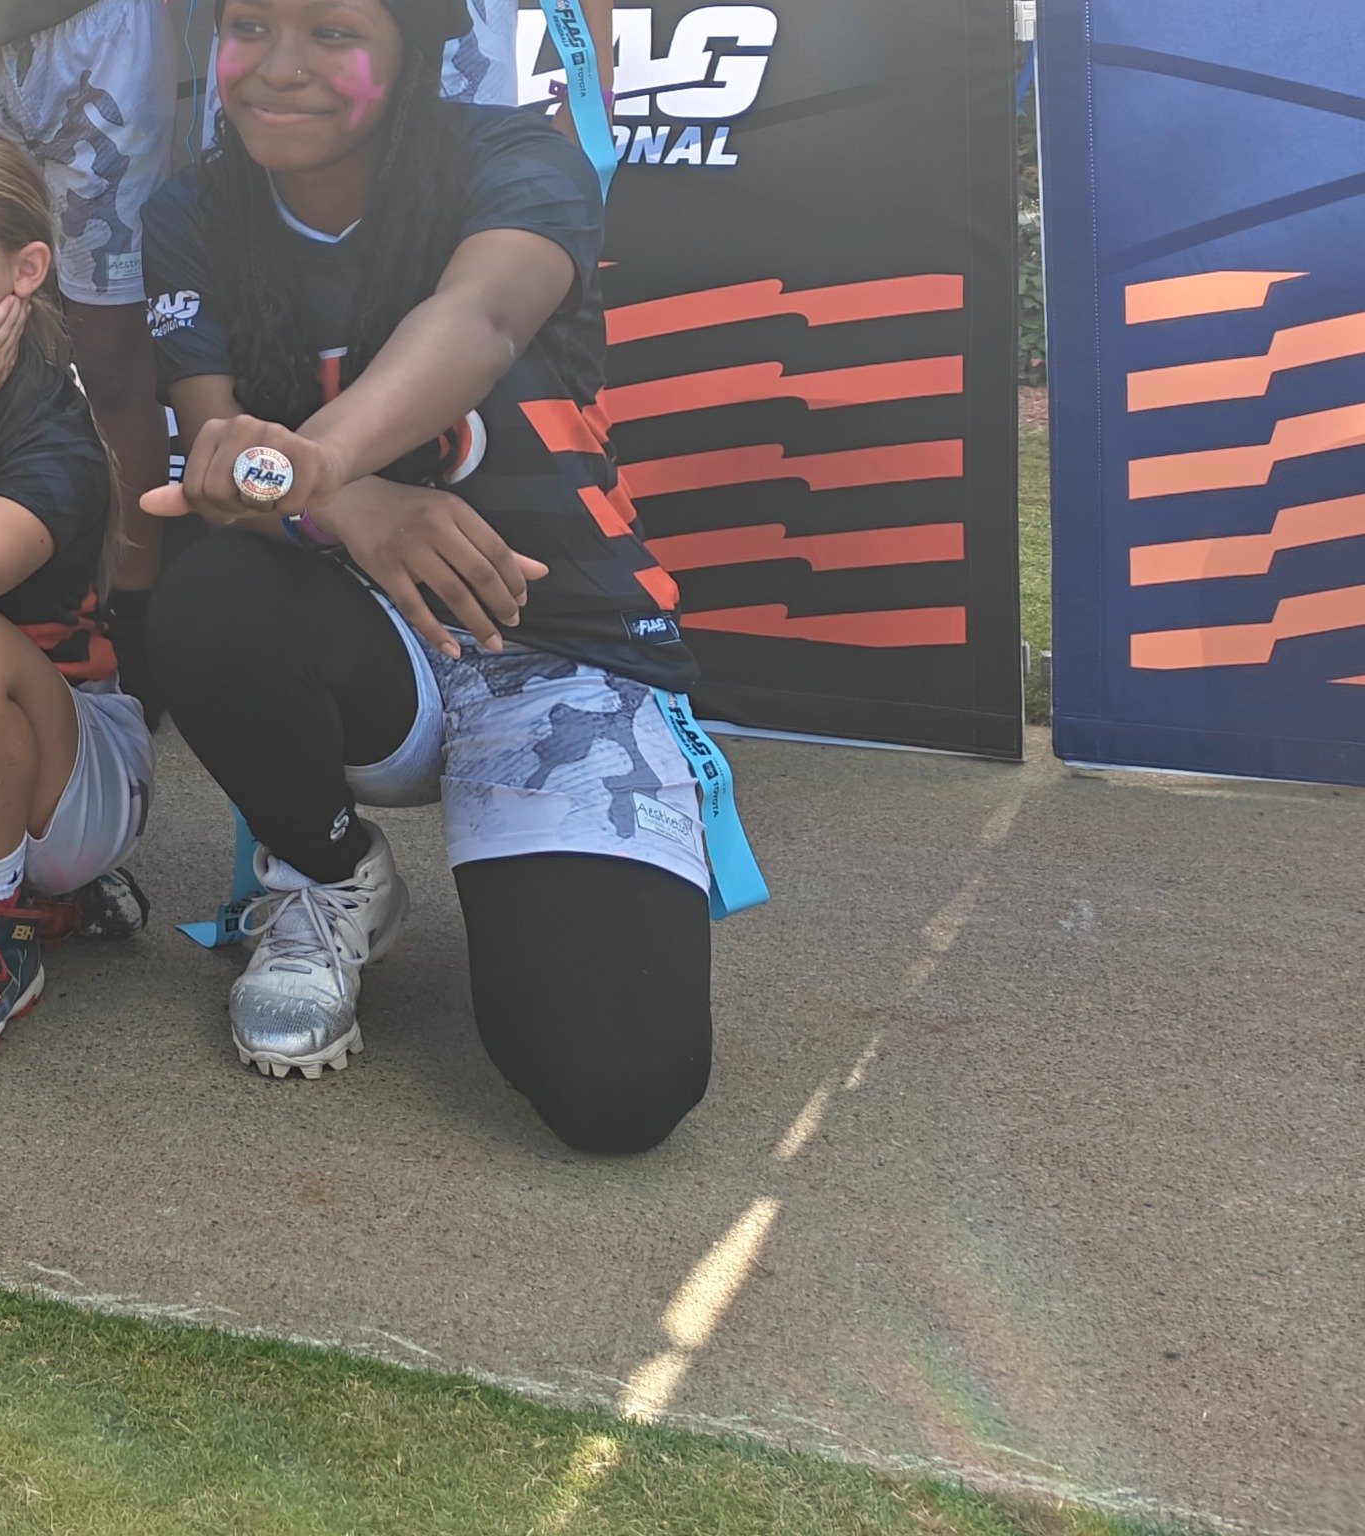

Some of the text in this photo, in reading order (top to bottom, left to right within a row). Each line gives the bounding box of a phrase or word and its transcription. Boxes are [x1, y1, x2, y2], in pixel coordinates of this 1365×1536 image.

[554, 8, 586, 49] FLAG
[243, 466, 287, 487] FLAG
[638, 617, 667, 636] FLAG
[668, 706, 712, 757] FLAG
